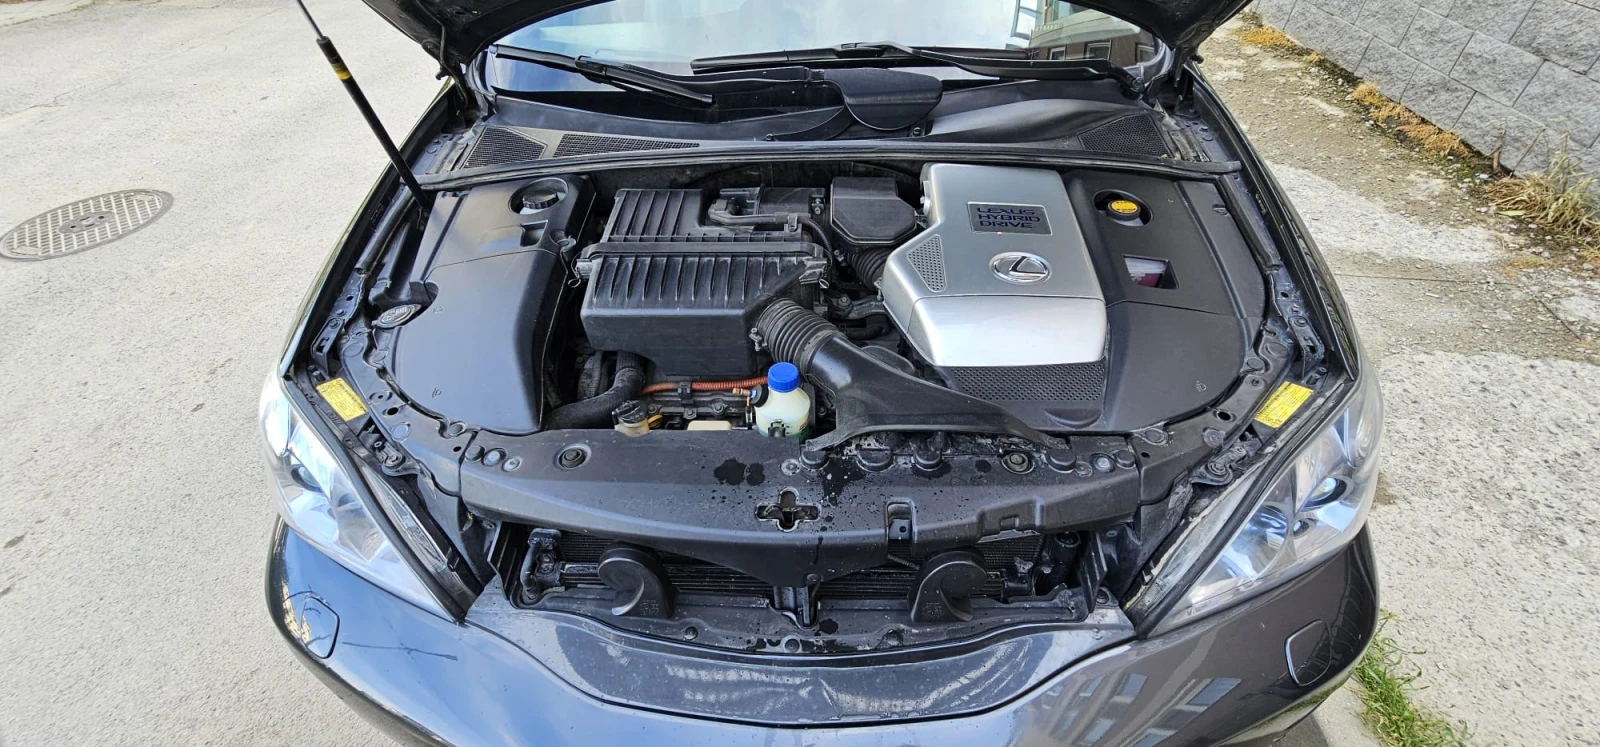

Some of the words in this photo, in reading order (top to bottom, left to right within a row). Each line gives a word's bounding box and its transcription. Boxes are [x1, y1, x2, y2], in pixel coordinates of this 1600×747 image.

[977, 207, 1036, 216] LEXUS
[978, 213, 1041, 223] HYBRID
[980, 220, 1034, 229] DRIVE
